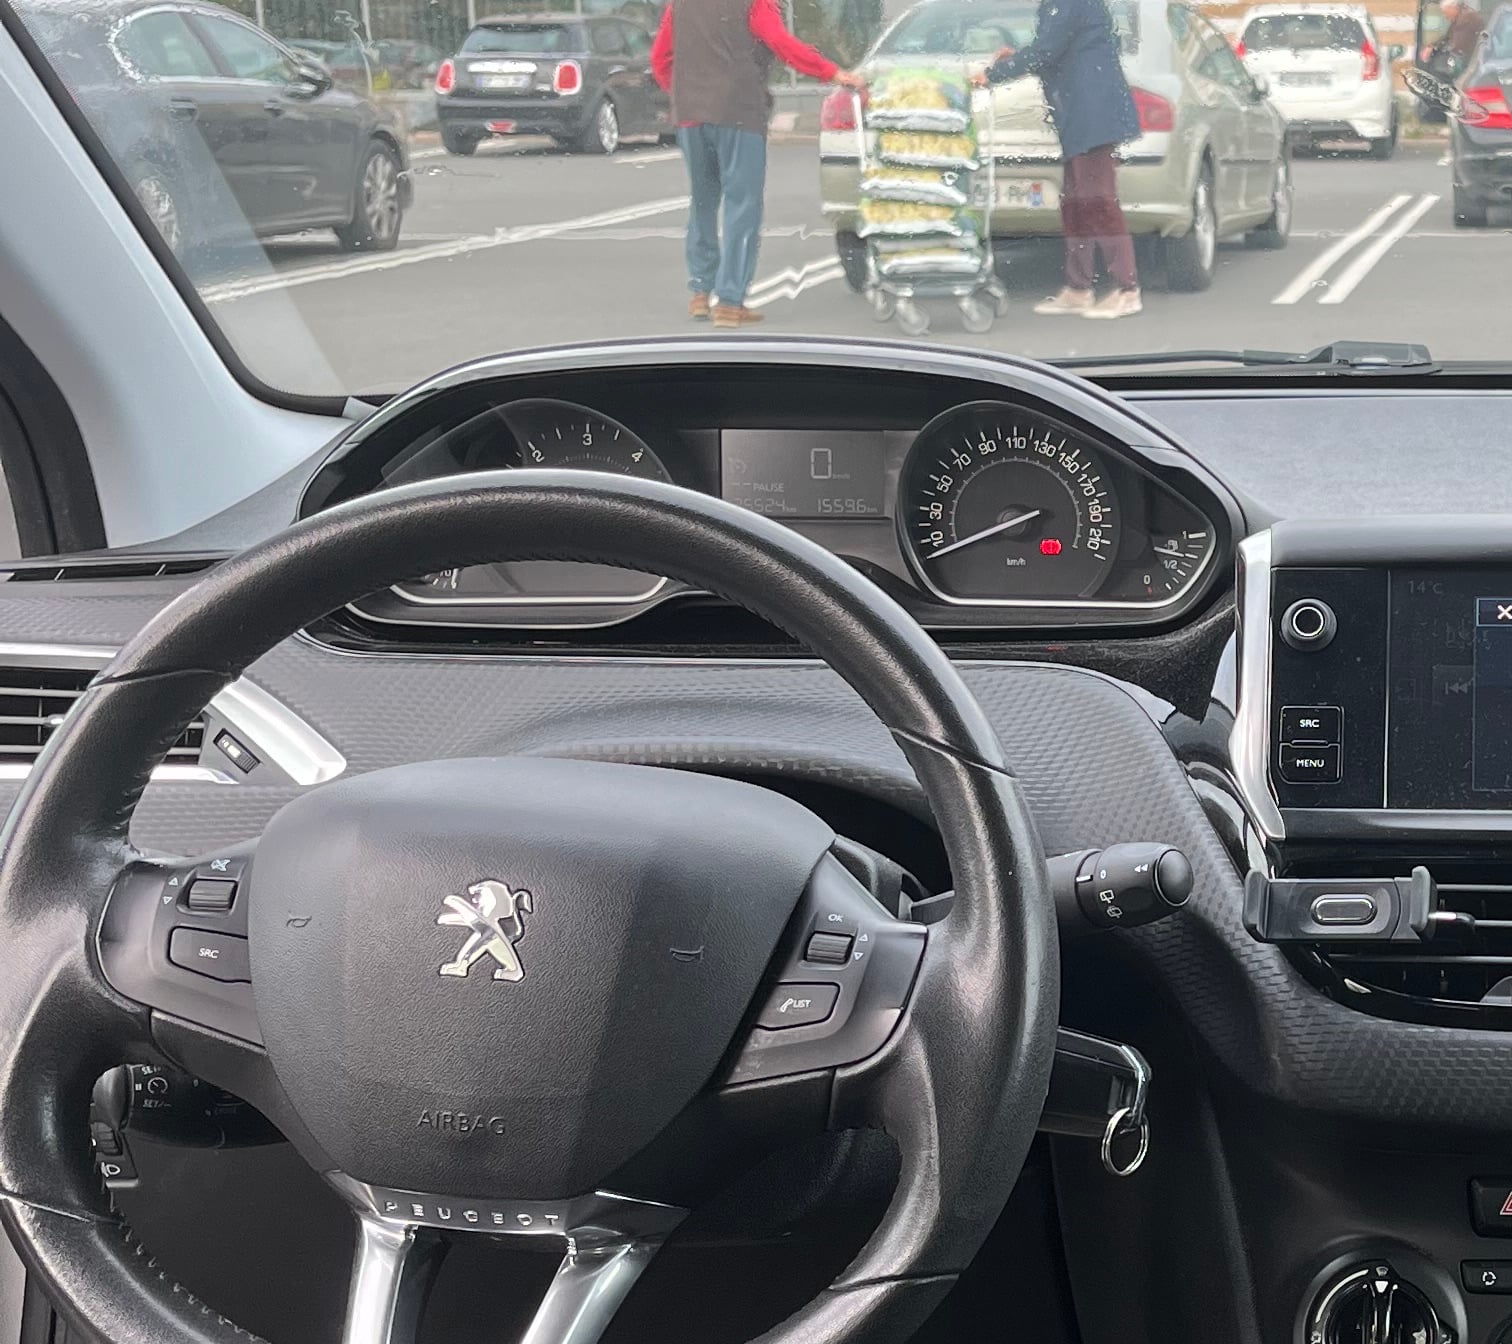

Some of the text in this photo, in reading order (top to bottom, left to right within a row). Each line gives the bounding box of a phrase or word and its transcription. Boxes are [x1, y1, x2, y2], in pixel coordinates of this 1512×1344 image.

[582, 433, 593, 446] 3
[1005, 436, 1027, 449] 110
[978, 440, 998, 456] 90
[1033, 439, 1057, 458] 130
[952, 453, 972, 471] 70
[1059, 452, 1080, 475] 150
[753, 483, 785, 493] PAUSE
[936, 475, 954, 493] 50
[1077, 473, 1096, 497] 170
[929, 502, 943, 520] 30
[1088, 498, 1103, 523] 190
[930, 530, 944, 548] 10
[1086, 527, 1102, 551] 210
[1006, 557, 1026, 567] km/h
[1163, 559, 1178, 570] 1/2
[1143, 574, 1151, 585] 0
[1300, 719, 1320, 728] SRC
[1296, 759, 1325, 768] MENU
[828, 913, 844, 923] OK
[199, 947, 219, 959] SRC
[793, 999, 811, 1008] LIST
[417, 1109, 507, 1135] AIRBAG
[384, 1201, 560, 1227] PEUGEOT
